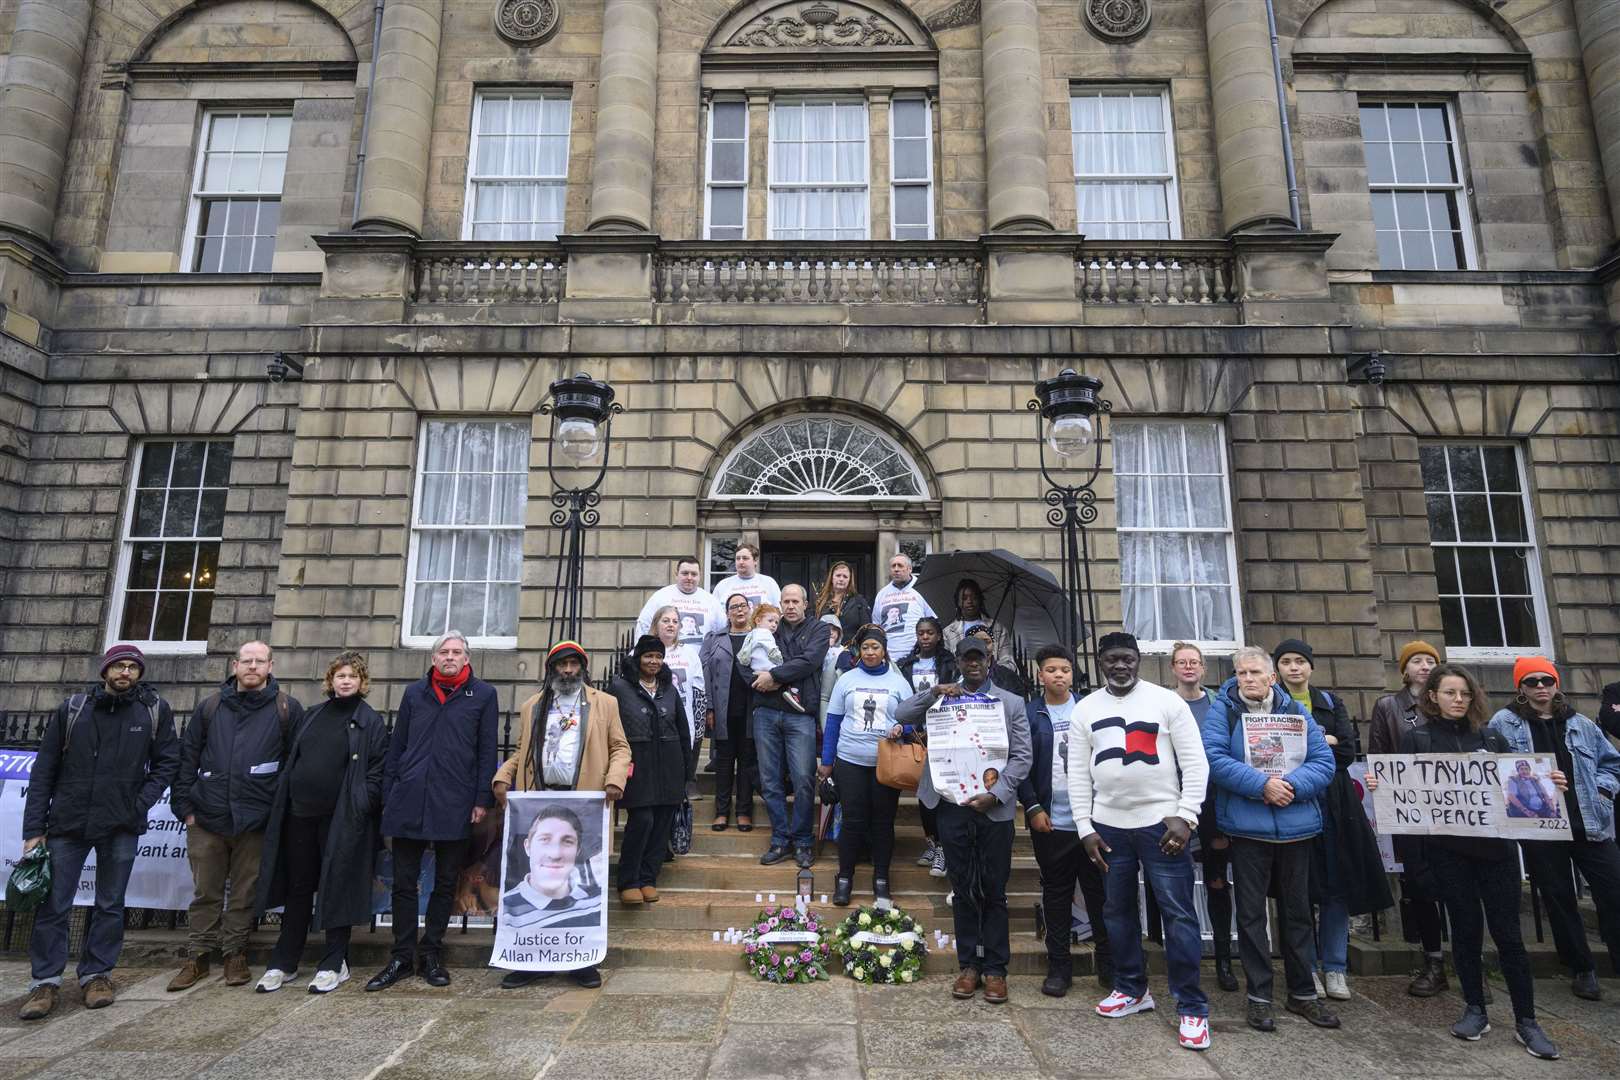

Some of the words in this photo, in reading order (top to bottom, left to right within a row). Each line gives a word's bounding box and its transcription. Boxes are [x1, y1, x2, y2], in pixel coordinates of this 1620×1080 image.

[1374, 760, 1406, 785] RIP
[1413, 760, 1502, 786] TAYLOR
[1393, 789, 1417, 805] NO
[1420, 789, 1493, 807] JUSTICE
[1396, 807, 1422, 824] NO
[1431, 807, 1490, 827] PEACE
[513, 931, 560, 946] Justice
[565, 931, 585, 945] for
[499, 948, 533, 963] Allan
[539, 948, 599, 963] Marshall
